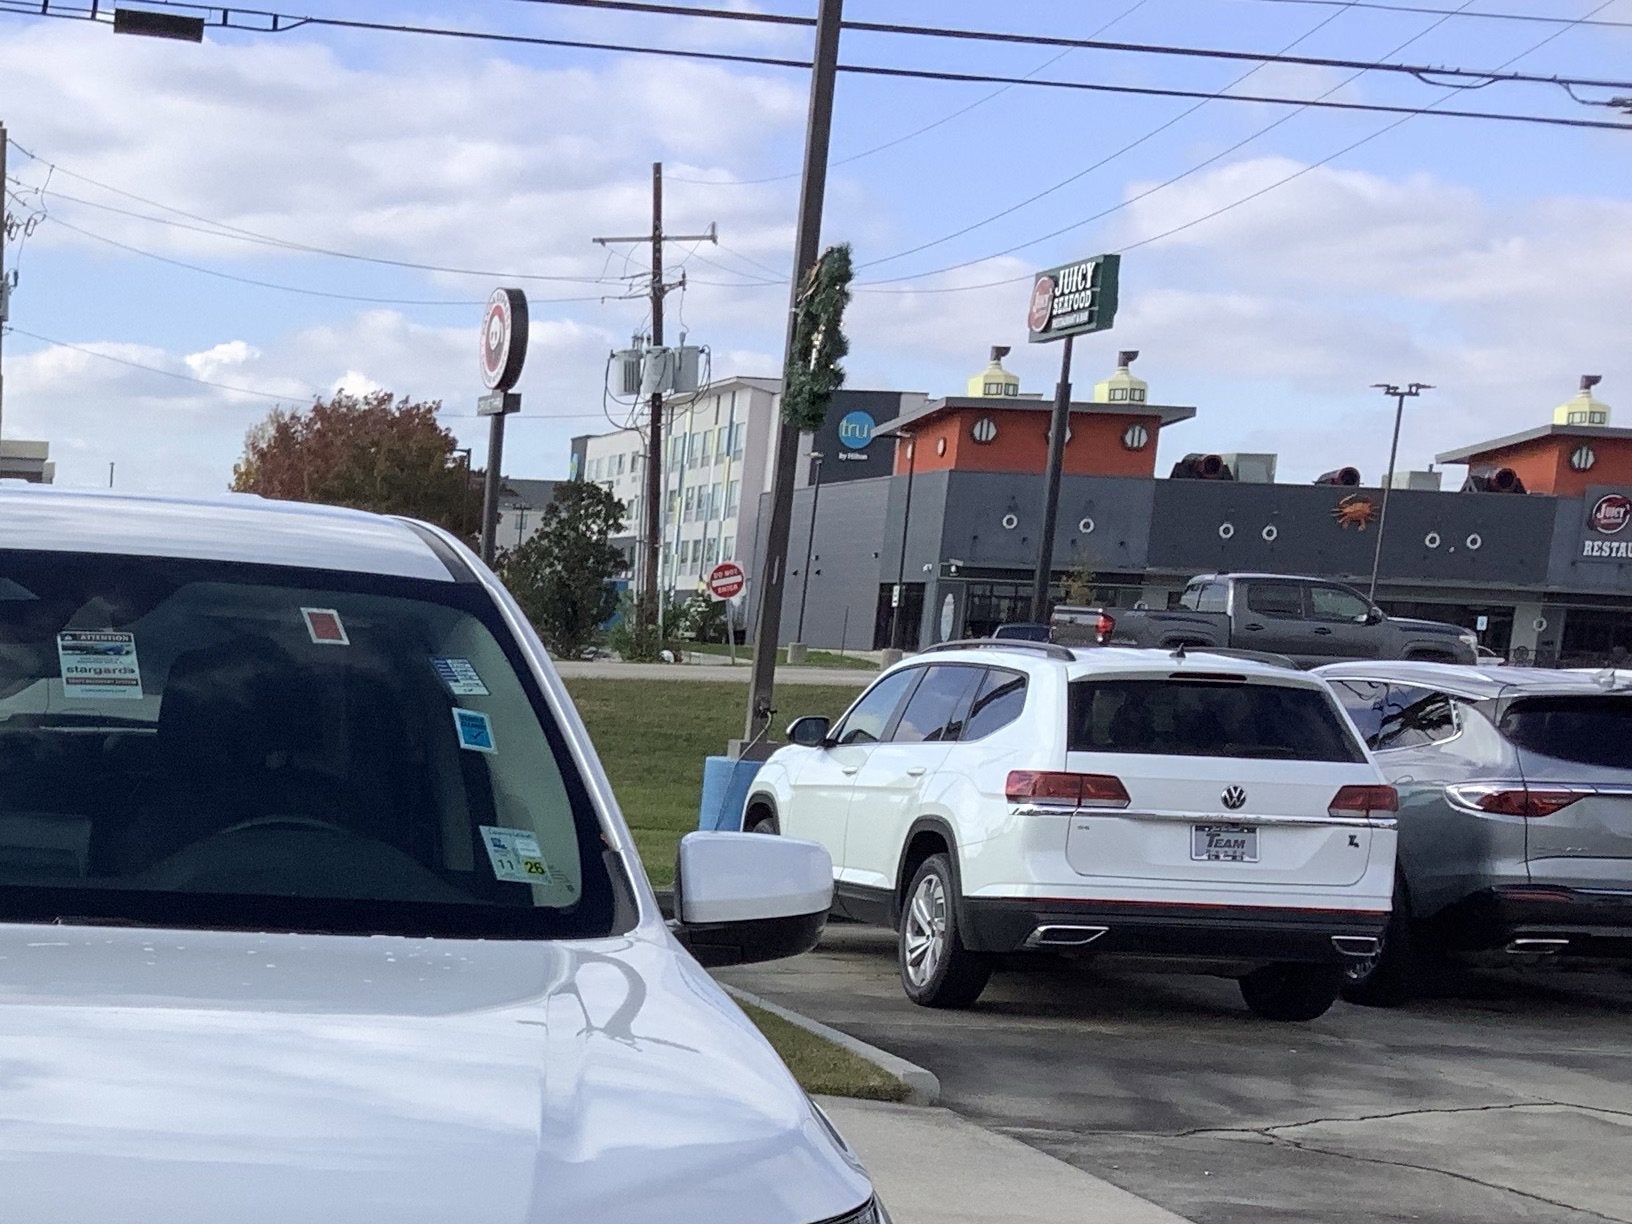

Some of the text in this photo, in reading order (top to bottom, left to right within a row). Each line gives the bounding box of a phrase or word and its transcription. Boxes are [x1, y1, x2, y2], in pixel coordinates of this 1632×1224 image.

[1055, 262, 1096, 296] JUICY
[1052, 290, 1092, 315] SEAFOOD
[842, 418, 868, 439] tru
[713, 568, 738, 579] DO NOT
[1206, 832, 1246, 849] TEAM
[497, 859, 545, 875] 11 26
